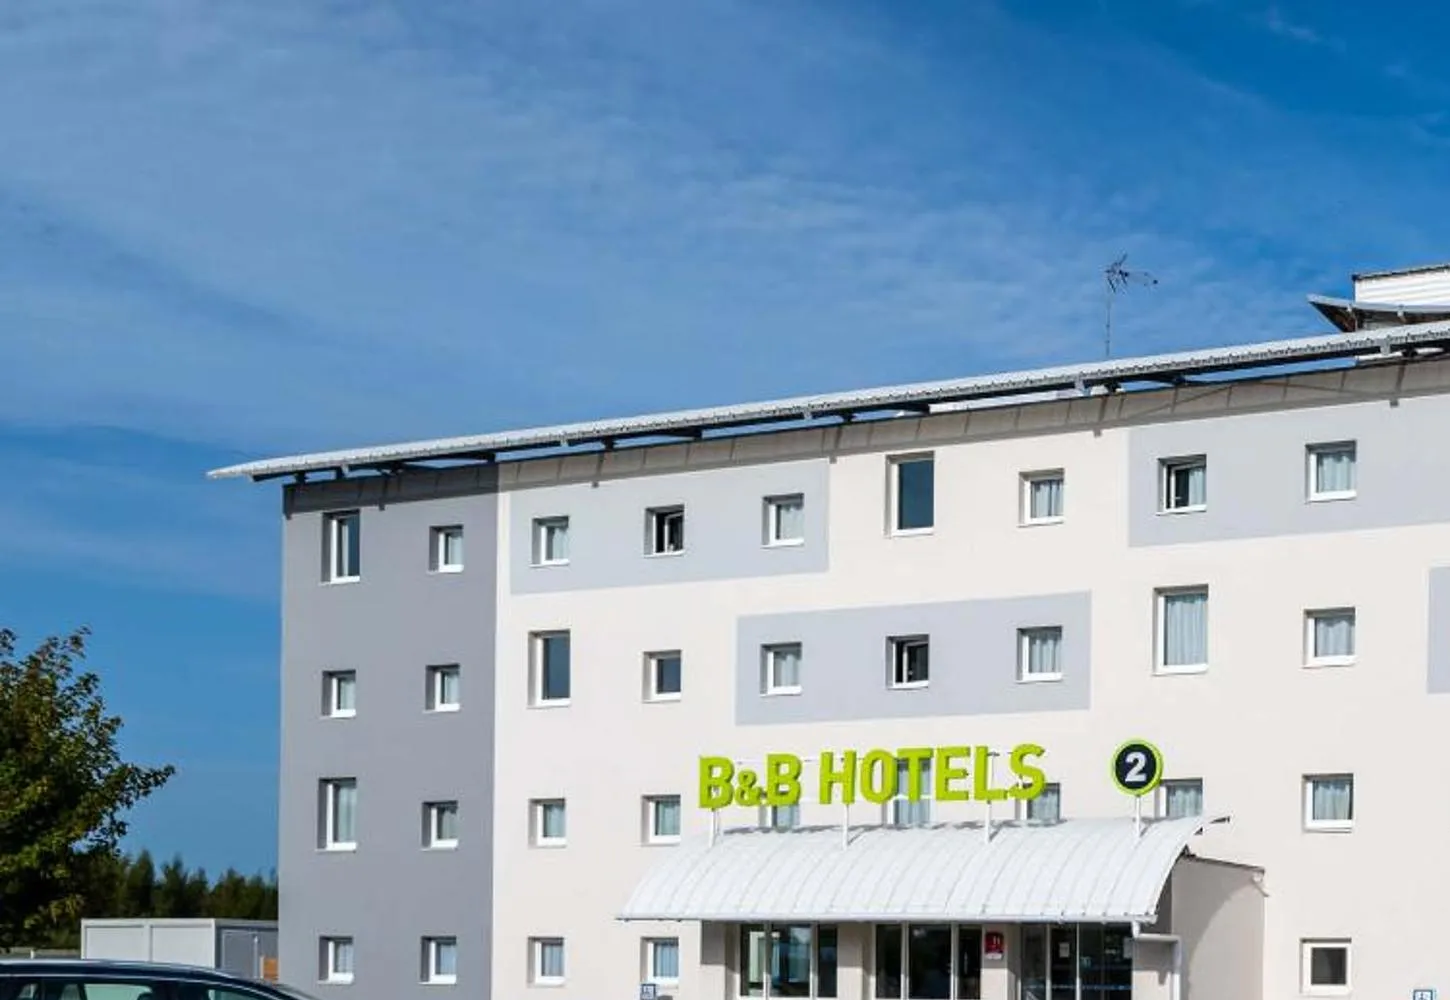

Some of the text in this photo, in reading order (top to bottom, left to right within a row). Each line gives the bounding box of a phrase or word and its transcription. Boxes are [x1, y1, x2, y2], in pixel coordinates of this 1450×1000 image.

[698, 743, 1047, 810] B&B HOTELS
[1124, 751, 1146, 783] 2
